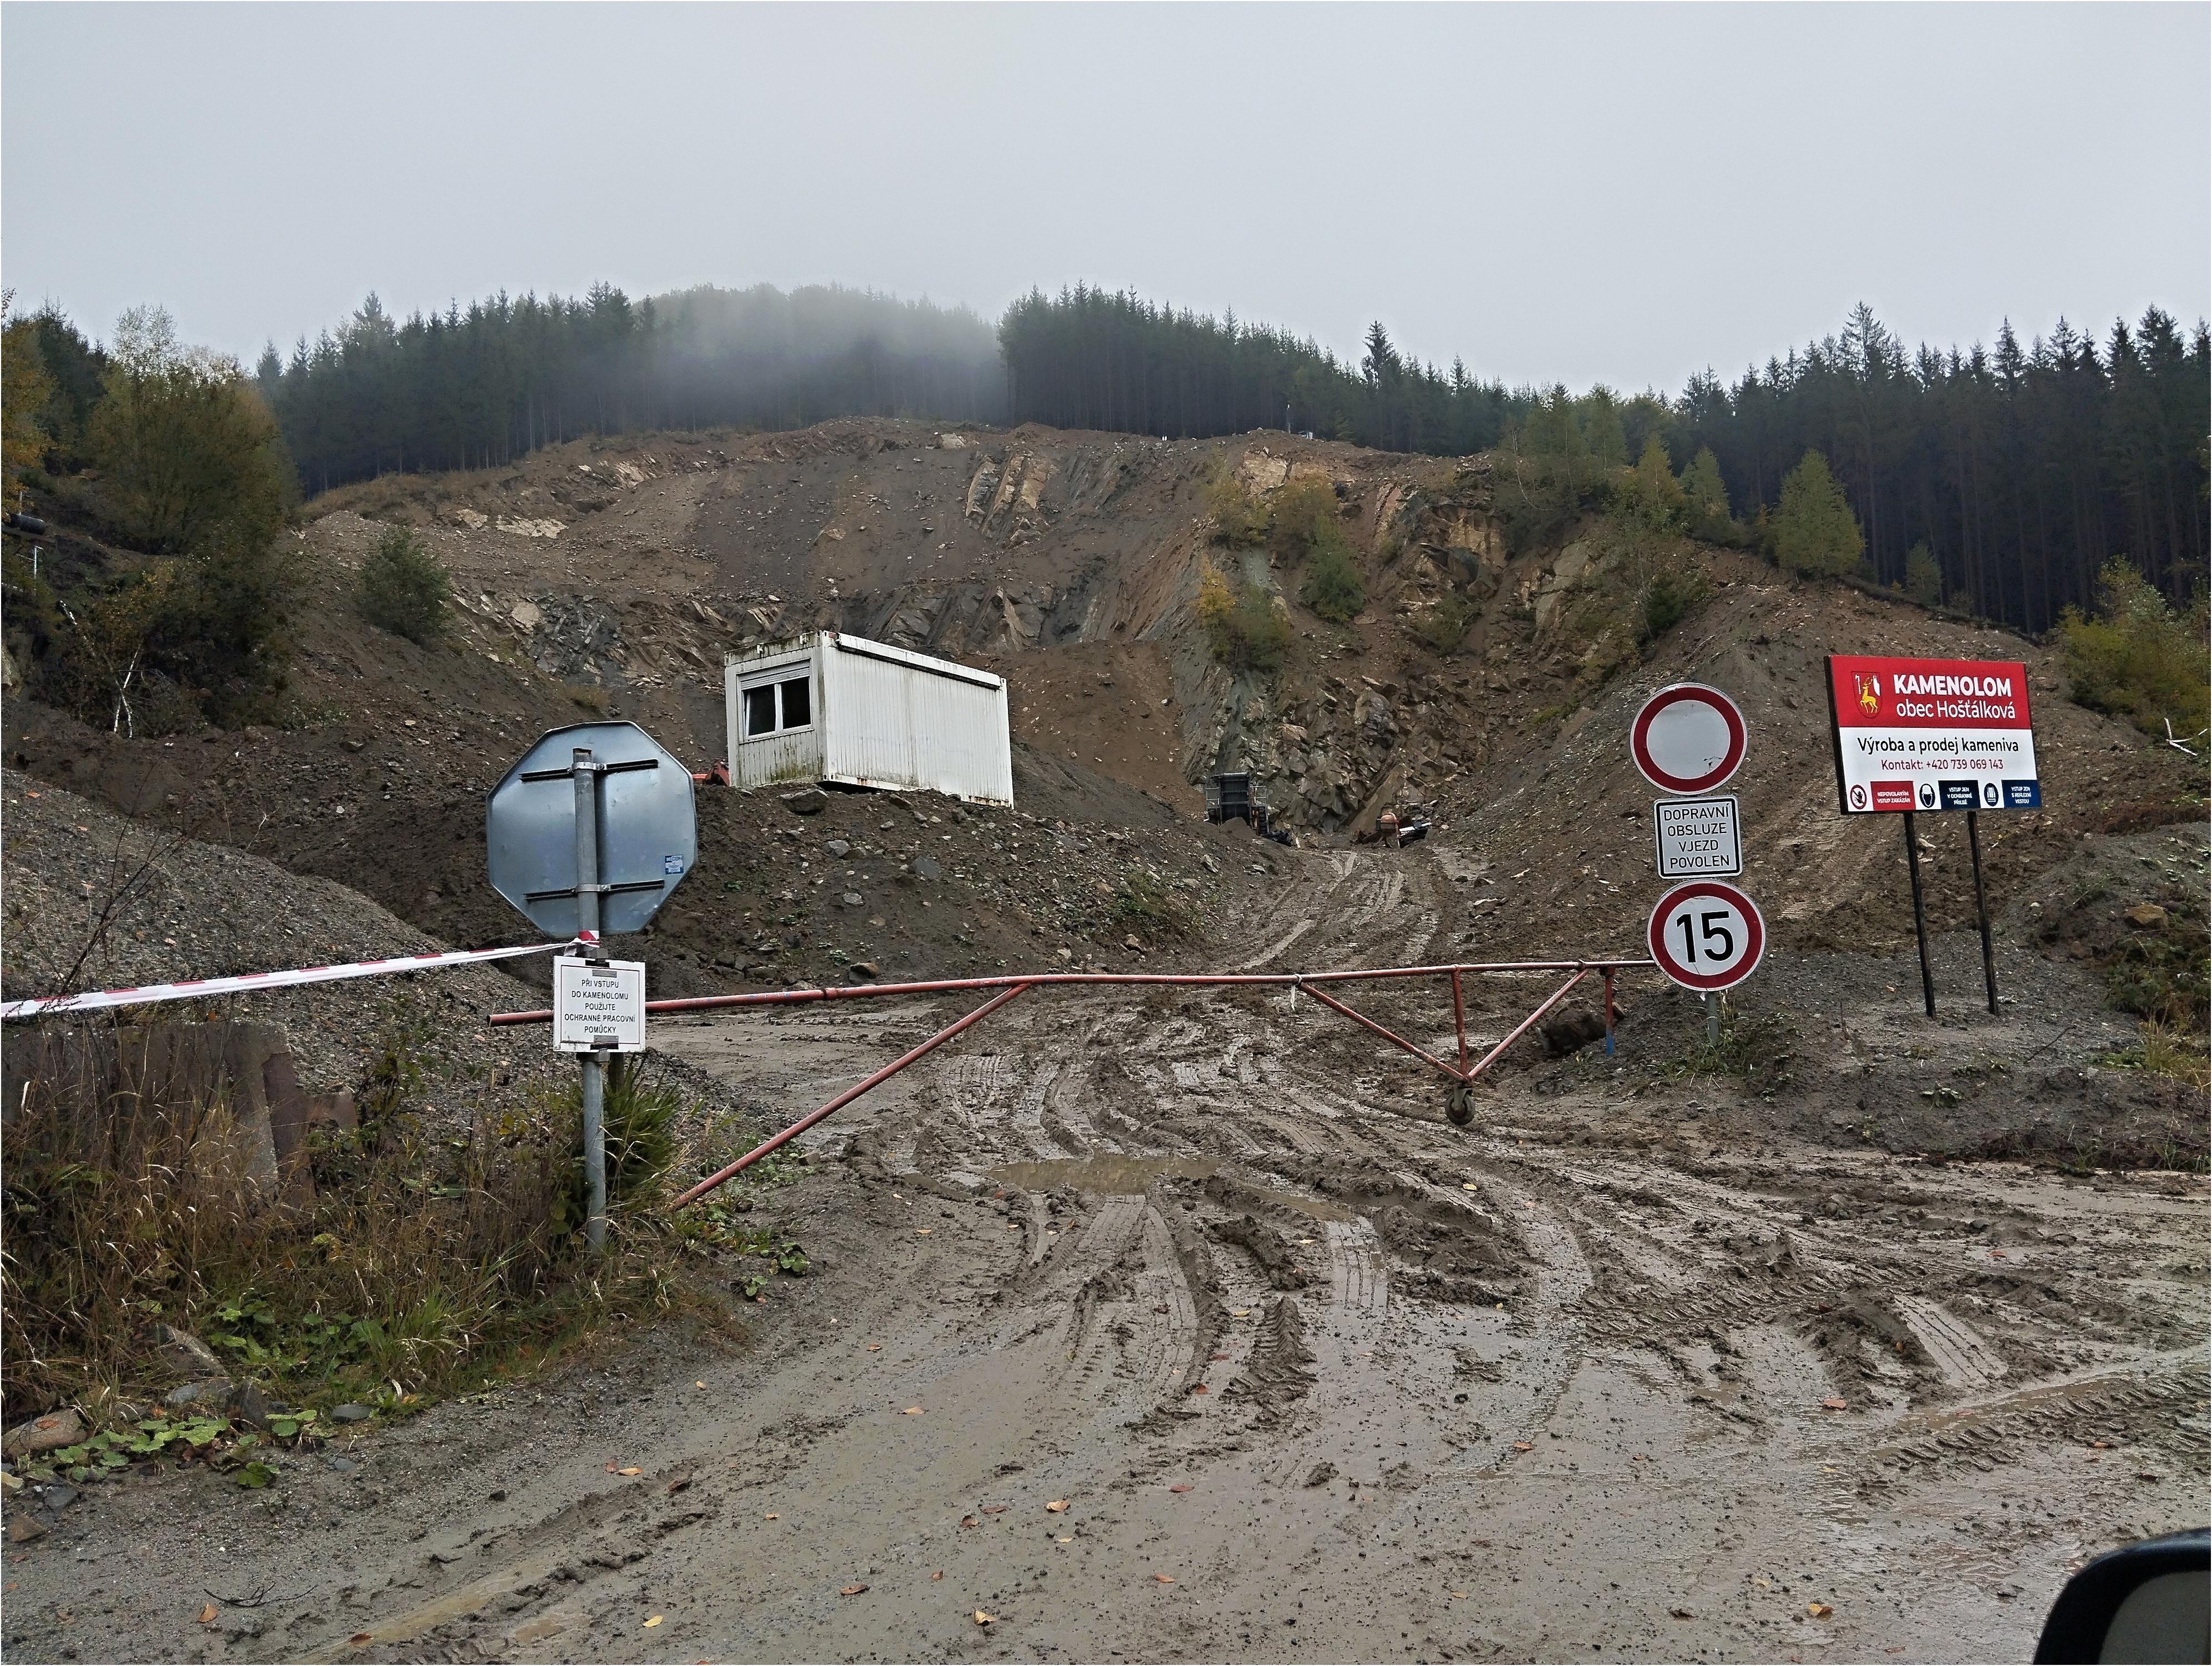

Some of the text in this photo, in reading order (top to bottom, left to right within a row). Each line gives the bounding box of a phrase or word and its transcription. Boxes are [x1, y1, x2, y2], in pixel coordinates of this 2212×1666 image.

[1893, 674, 2012, 697] KAMENOLOM
[1897, 699, 2015, 719] obec Hošťálková
[1858, 737, 2019, 755] Výroba a prodej kameniva
[1881, 759, 2003, 770] Kontakt: +420 739 069 143
[1663, 803, 1730, 821] DOPRAVNÍ
[1667, 823, 1727, 837] OBSLUZE
[1678, 839, 1719, 852] VJEZD
[1670, 855, 1730, 870] POVOLEN
[1676, 910, 1734, 964] 15
[581, 978, 592, 987] PŘI
[583, 991, 629, 1000] KAMENOLOMU
[564, 1013, 601, 1022] OCHRANNÉ
